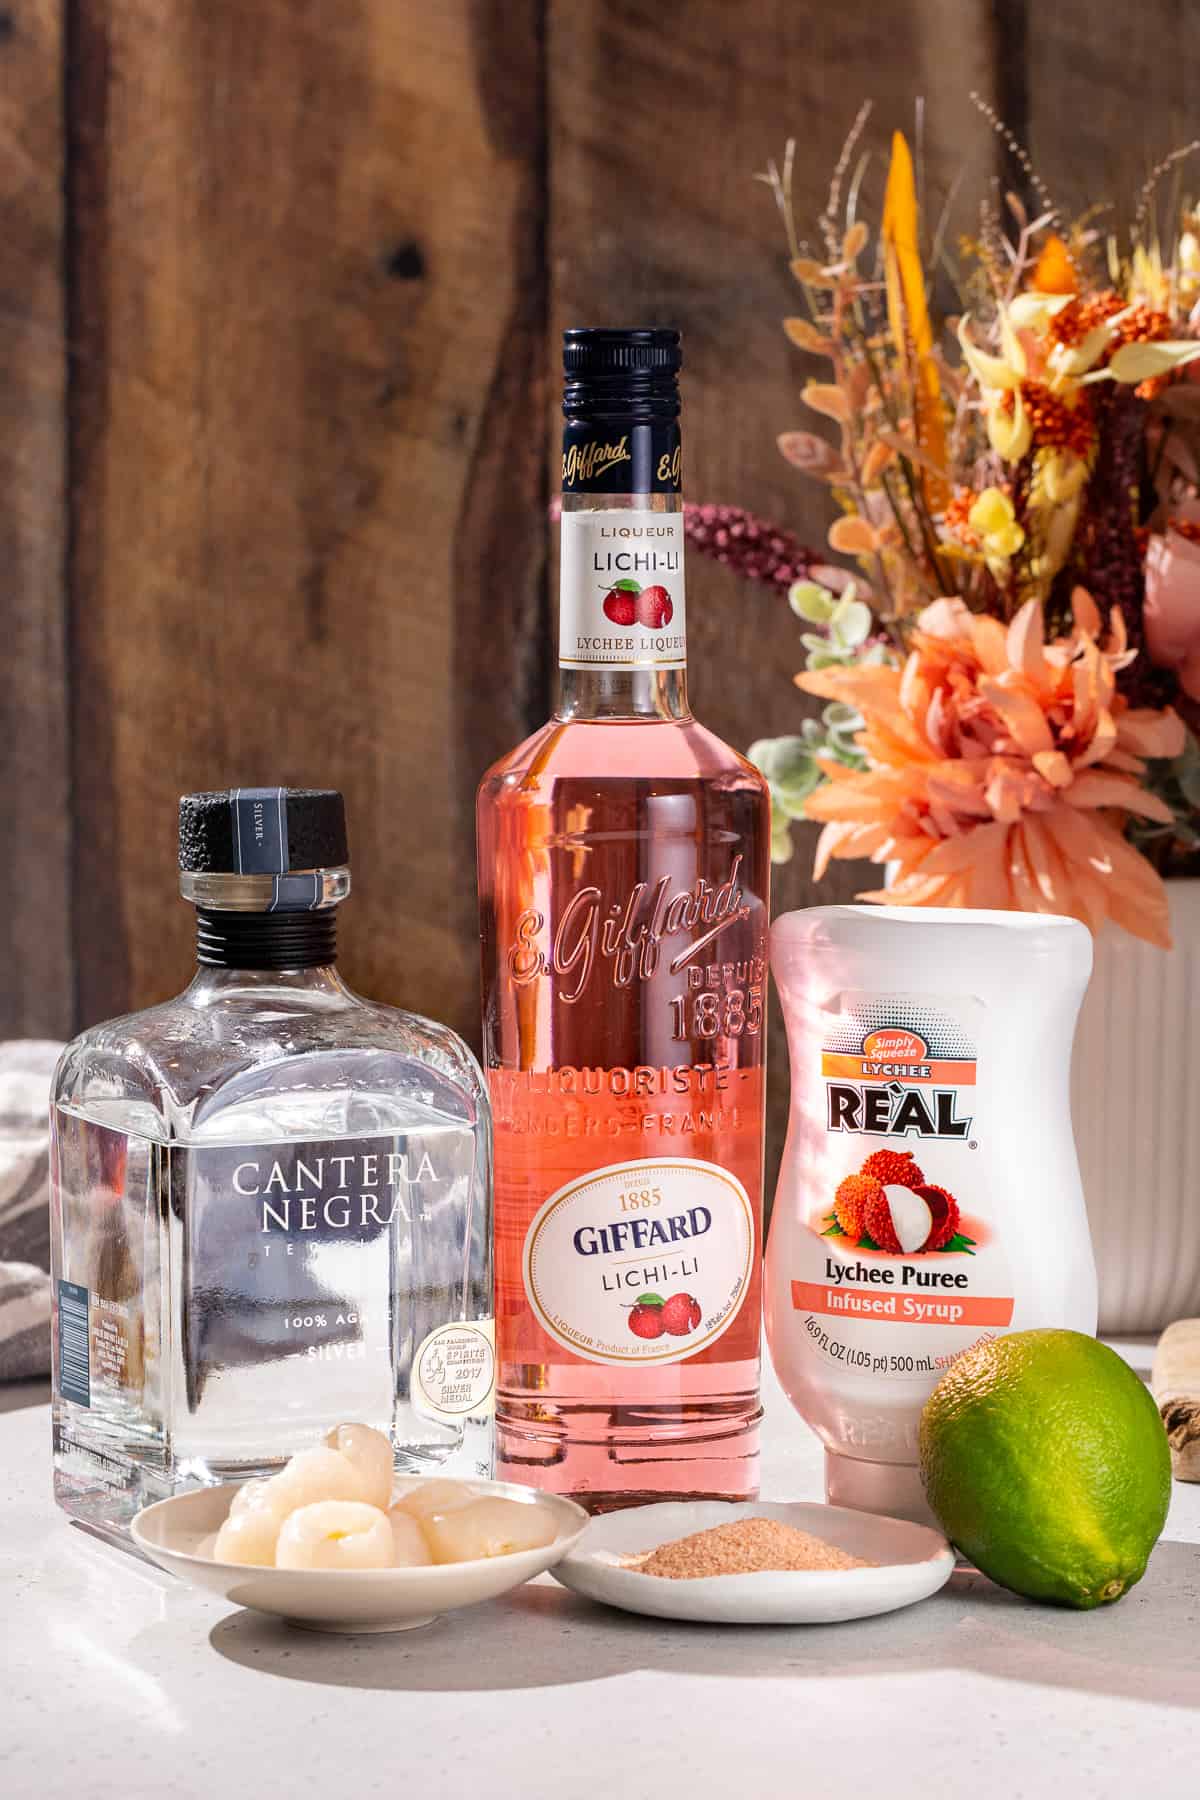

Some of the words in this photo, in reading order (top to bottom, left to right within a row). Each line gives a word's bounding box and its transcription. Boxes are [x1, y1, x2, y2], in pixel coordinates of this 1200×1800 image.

[600, 527, 675, 538] LIQUEUR
[593, 552, 680, 571] LICHI-LI
[577, 637, 634, 650] LYCHEE
[253, 802, 265, 840] SILVER
[668, 985, 764, 1041] 1885
[870, 1047, 917, 1060] Squeeze
[875, 1037, 914, 1049] Simply
[862, 1062, 932, 1078] LYCHEE
[232, 1151, 440, 1195] CANTERA
[261, 1192, 413, 1233] NEGRA
[618, 1188, 662, 1211] 1885
[573, 1206, 713, 1256] GIFFARD
[602, 1257, 699, 1291] LICHI-LI
[825, 1259, 895, 1289] Lychee
[902, 1265, 969, 1289] Puree
[826, 1290, 896, 1314] Infused
[903, 1297, 964, 1321] Syrup
[284, 1314, 328, 1329] 100%
[552, 1314, 594, 1346] LIQUEUR
[803, 1315, 822, 1339] 16.9
[818, 1333, 829, 1352] FL
[829, 1341, 846, 1360] OZ
[846, 1348, 871, 1368] (1.05
[872, 1355, 888, 1373] pt)
[890, 1356, 914, 1372] 500
[916, 1355, 935, 1372] mL
[455, 1367, 482, 1380] 2017
[440, 1383, 472, 1395] SILVER
